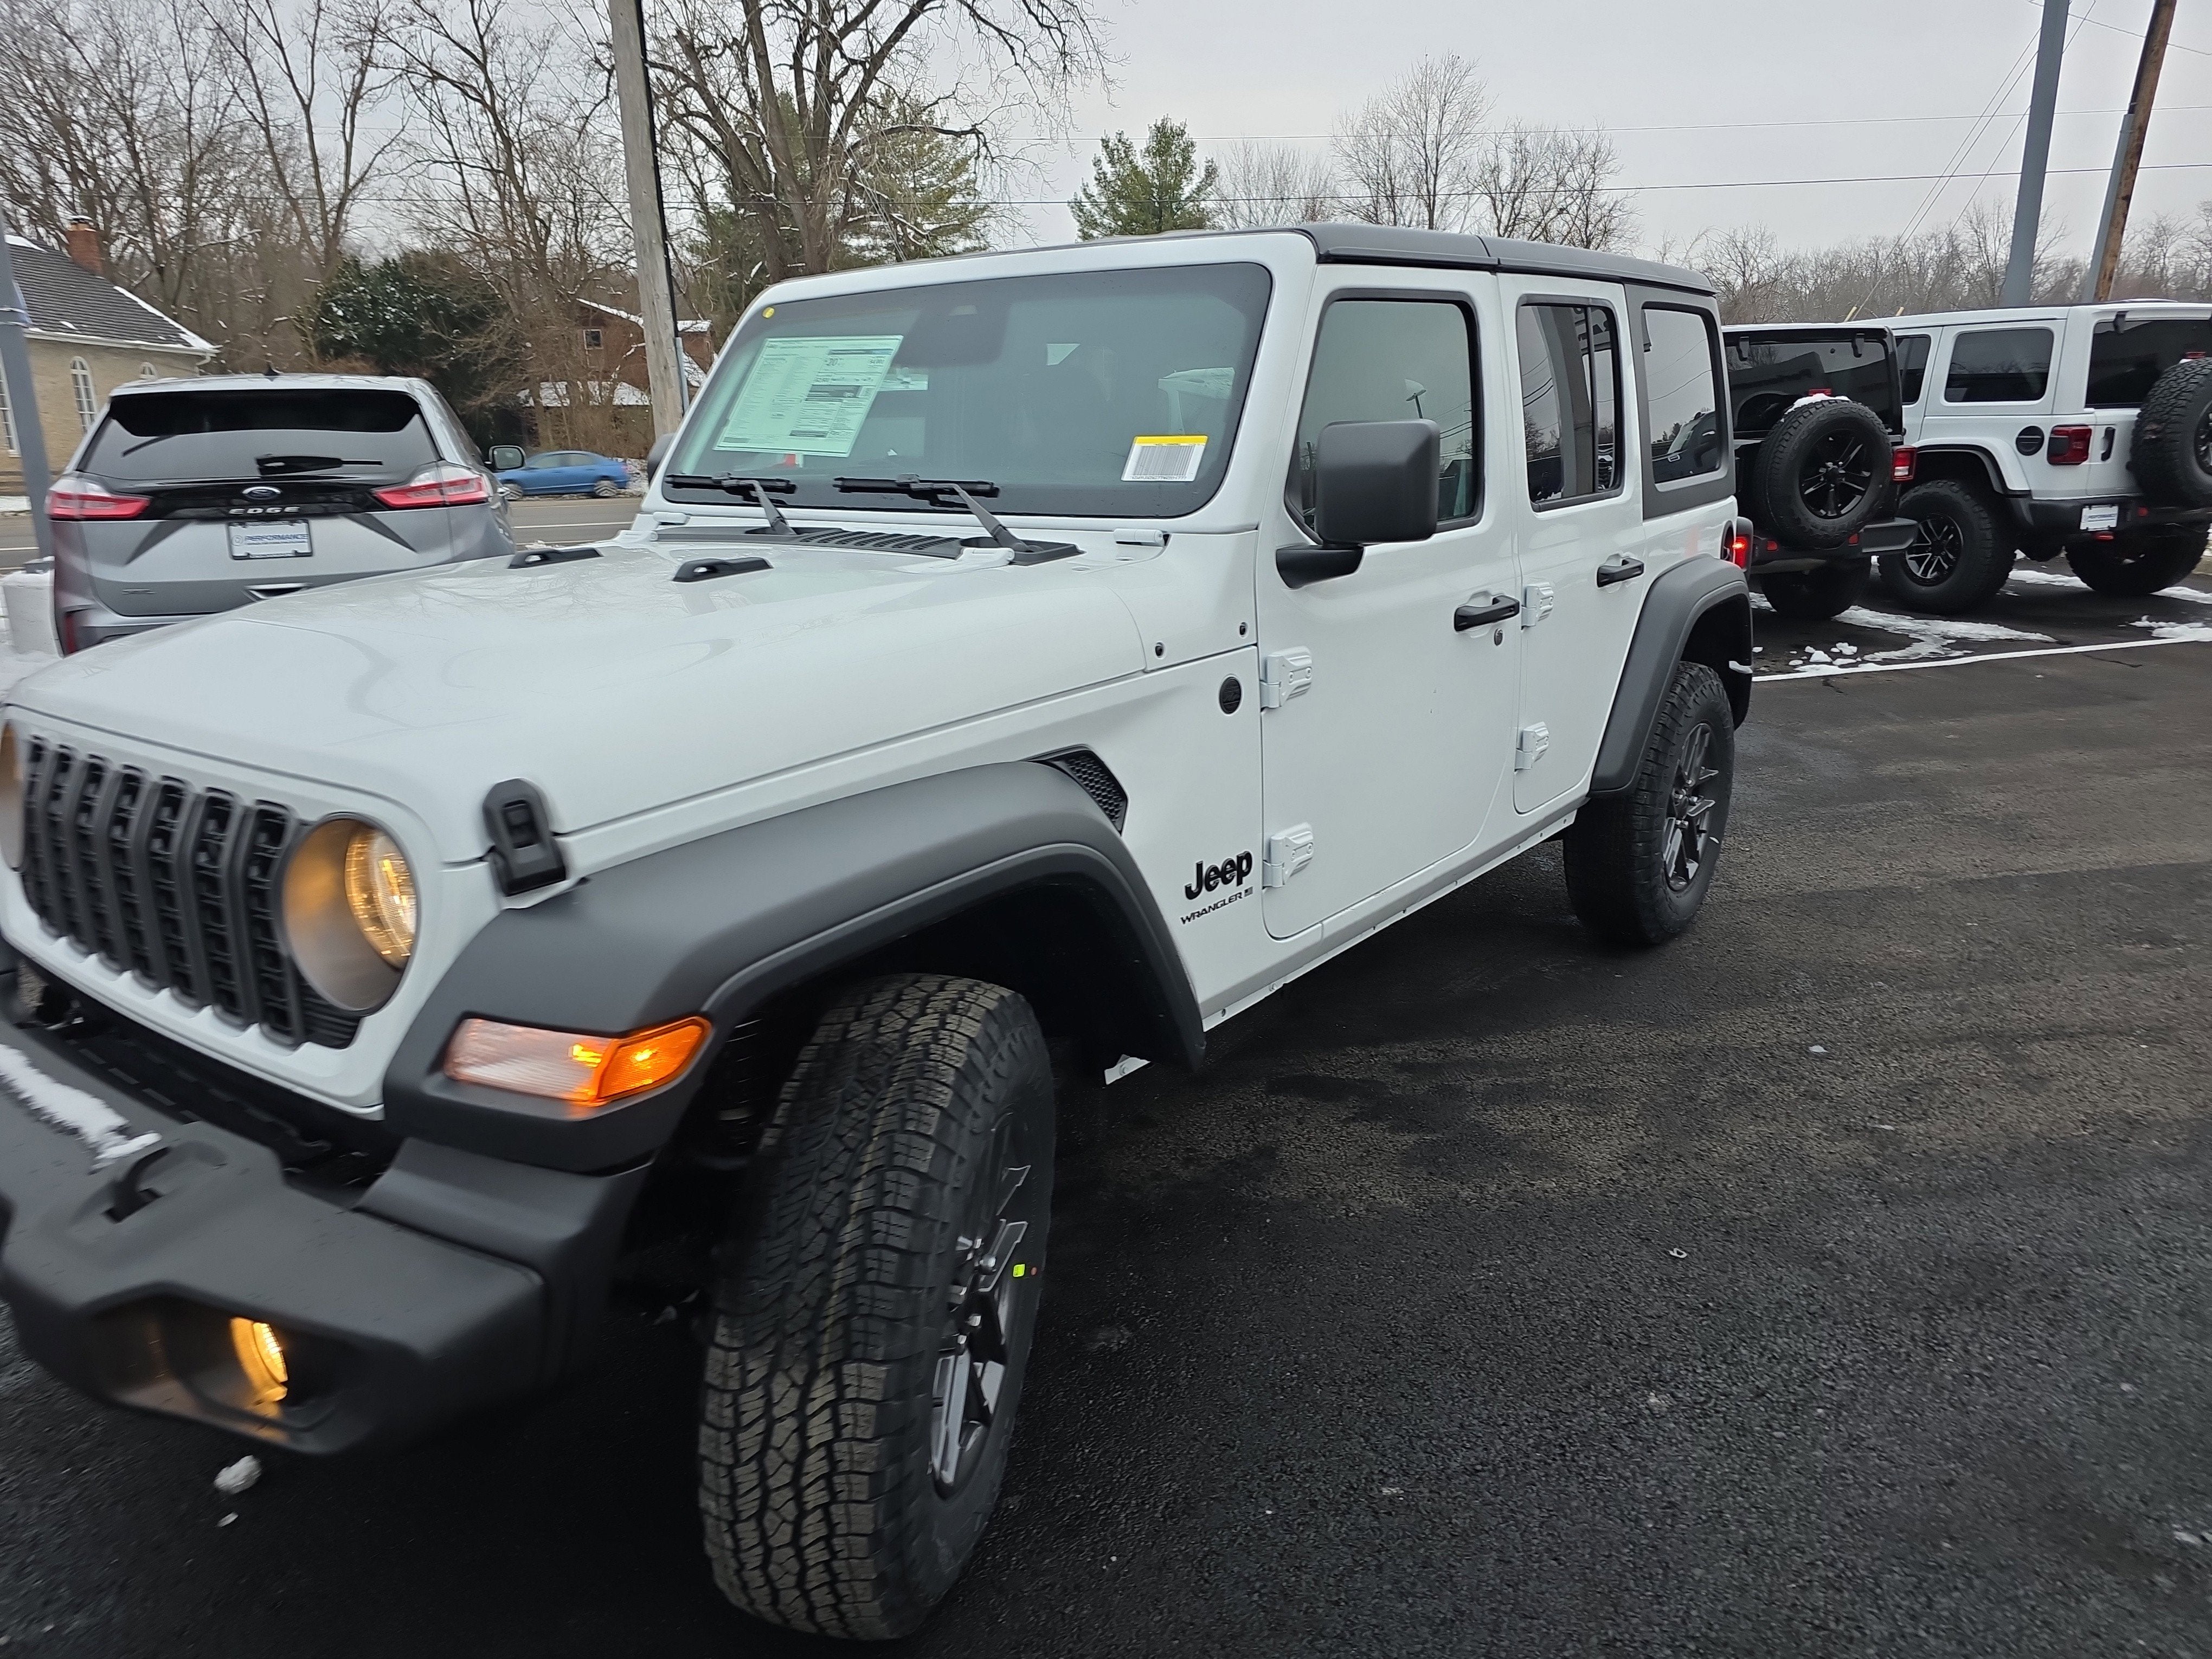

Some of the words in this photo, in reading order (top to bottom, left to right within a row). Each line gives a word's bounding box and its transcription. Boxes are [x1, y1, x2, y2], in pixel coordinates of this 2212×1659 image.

[229, 506, 300, 515] EDGE
[1185, 851, 1252, 900] Jeep
[1180, 892, 1243, 924] WRANGLER
